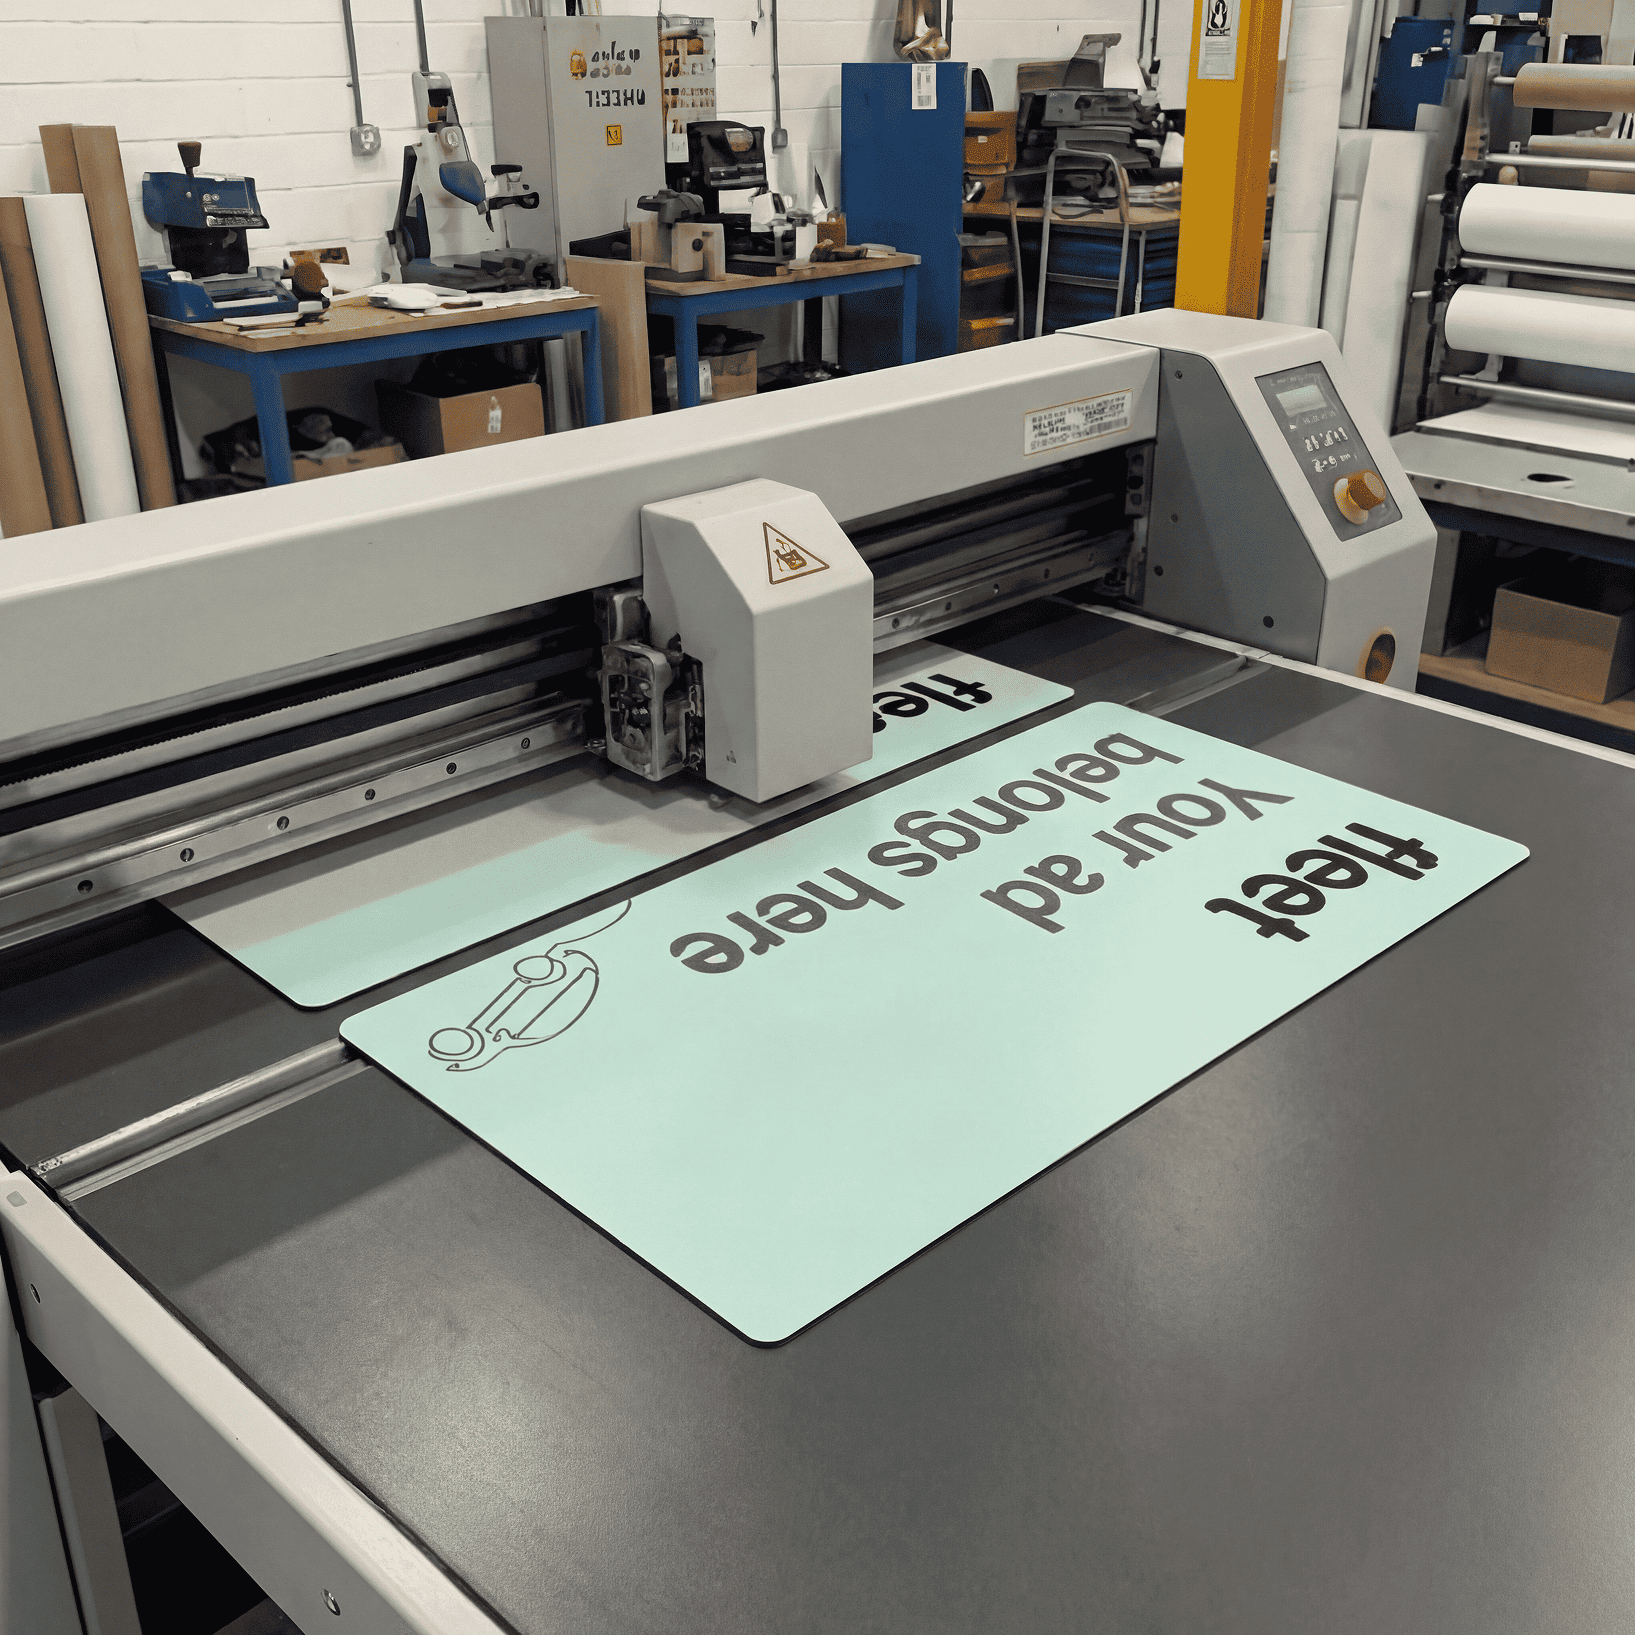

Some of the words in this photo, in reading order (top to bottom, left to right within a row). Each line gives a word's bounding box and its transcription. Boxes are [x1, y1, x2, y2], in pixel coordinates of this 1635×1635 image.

[867, 732, 1185, 877] belongs
[1091, 778, 1294, 869] Your
[669, 867, 905, 974] here
[979, 854, 1105, 934] ad
[1204, 822, 1439, 943] fleet
